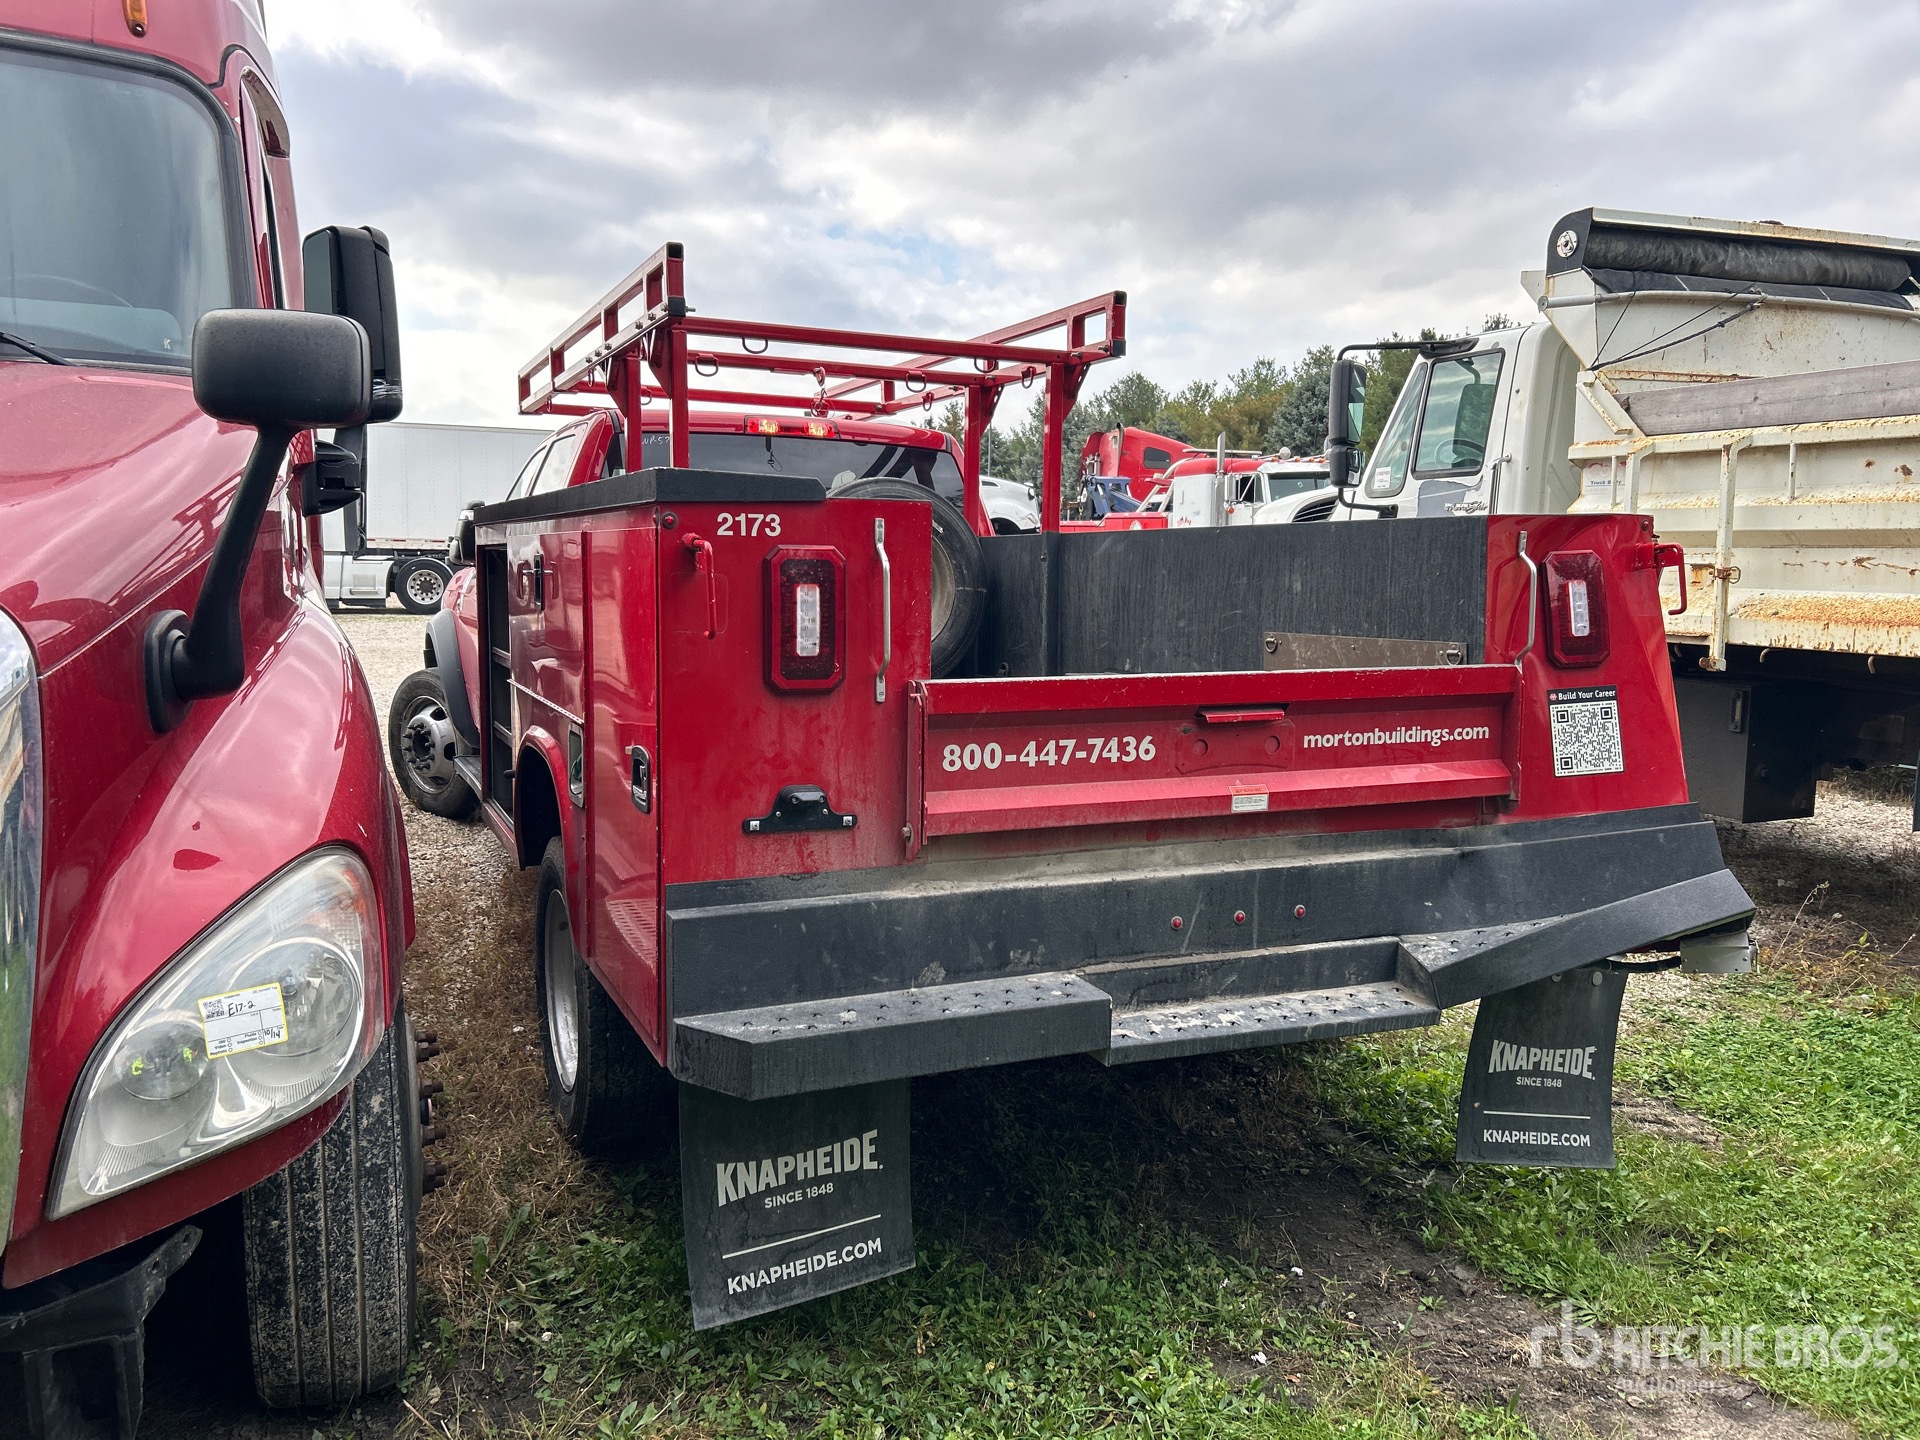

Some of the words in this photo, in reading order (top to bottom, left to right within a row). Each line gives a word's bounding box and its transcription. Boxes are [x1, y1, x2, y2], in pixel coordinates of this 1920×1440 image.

[717, 512, 781, 537] 2173
[1558, 691, 1576, 700] Build
[1577, 690, 1593, 699] Your
[1594, 689, 1616, 698] Career
[1303, 726, 1489, 748] mortonbuildings.com
[942, 735, 1156, 772] 800-447-7436
[228, 1000, 256, 1017] E17-2
[264, 1028, 281, 1039] 10/14
[1515, 1076, 1542, 1087] SINCE
[1543, 1078, 1562, 1088] 1848
[1483, 1129, 1591, 1147] KNAPHEIDE.COM
[764, 1190, 803, 1209] SINCE
[806, 1182, 834, 1199] 1848
[727, 1238, 882, 1295] KNAPHEIDE.COM
